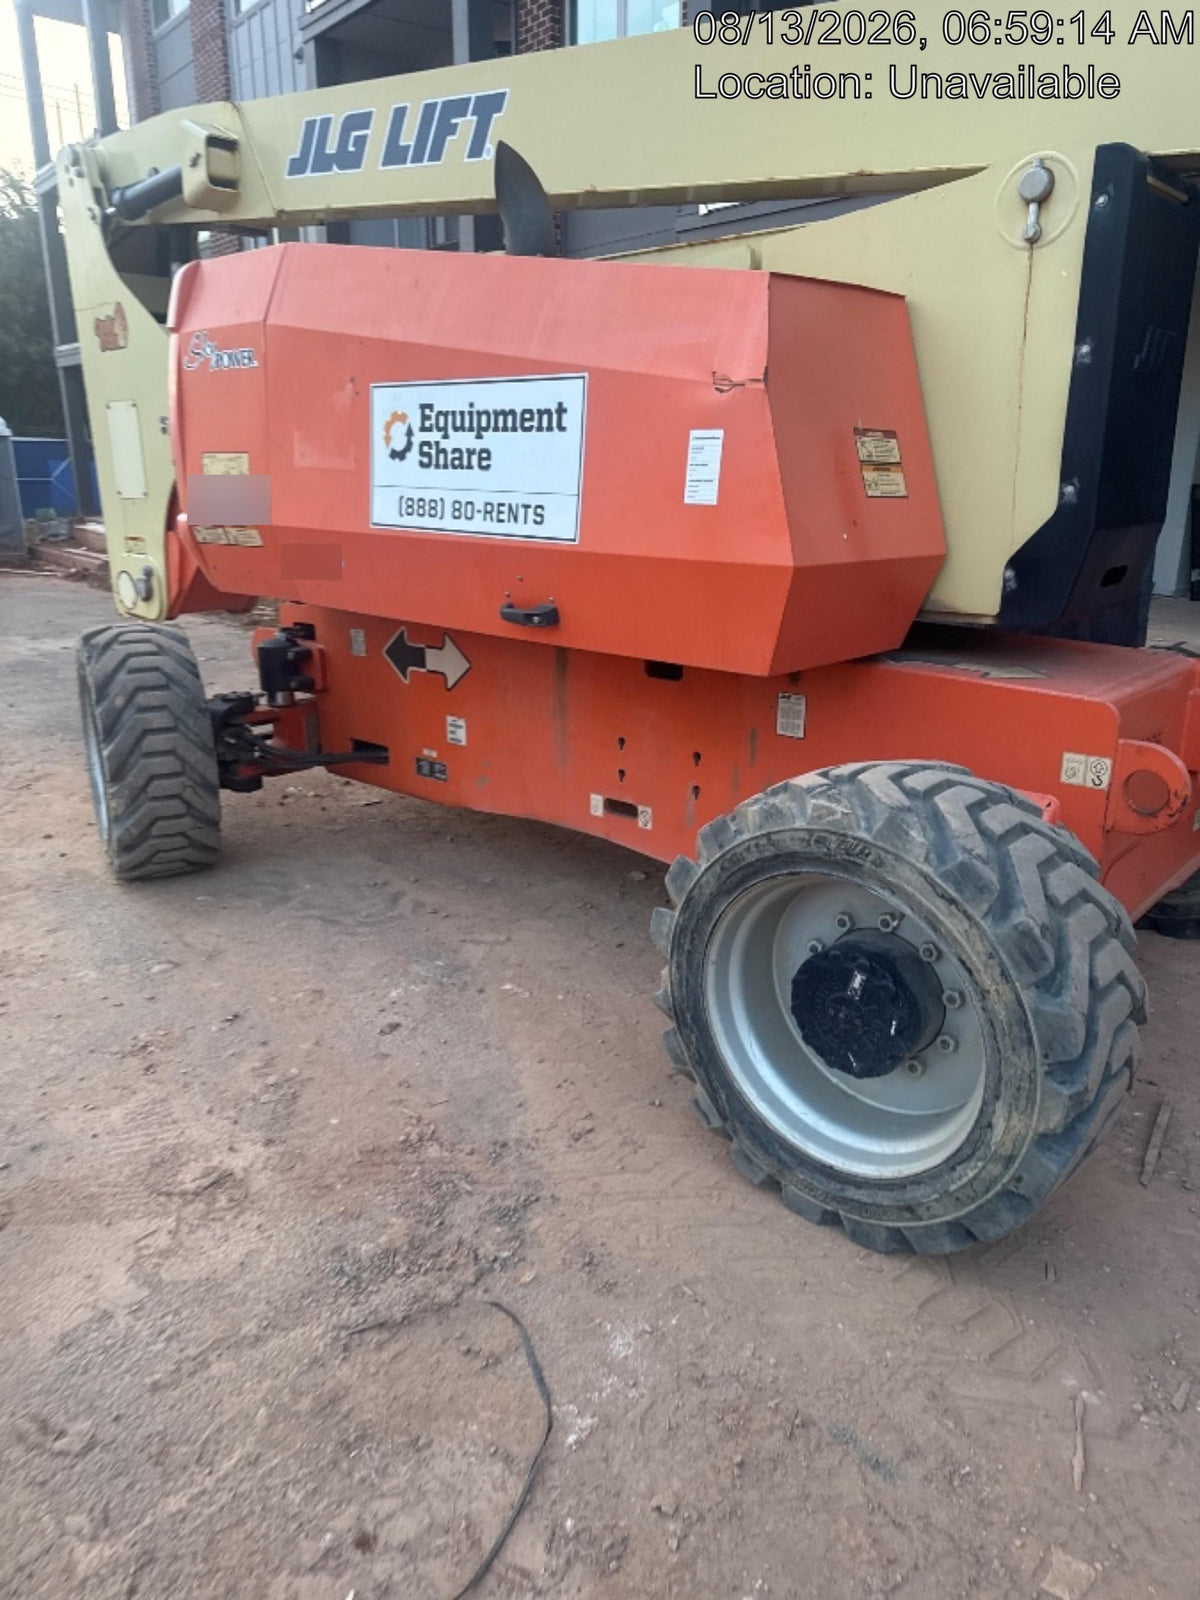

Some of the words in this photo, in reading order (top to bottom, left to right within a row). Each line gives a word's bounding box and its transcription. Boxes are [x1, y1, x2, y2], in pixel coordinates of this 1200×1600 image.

[285, 109, 375, 178] JLG
[379, 89, 509, 169] LIFT
[418, 402, 567, 439] Equipment
[418, 441, 491, 471] Share
[399, 496, 445, 520] (888)
[451, 500, 545, 525] 80-RENTS
